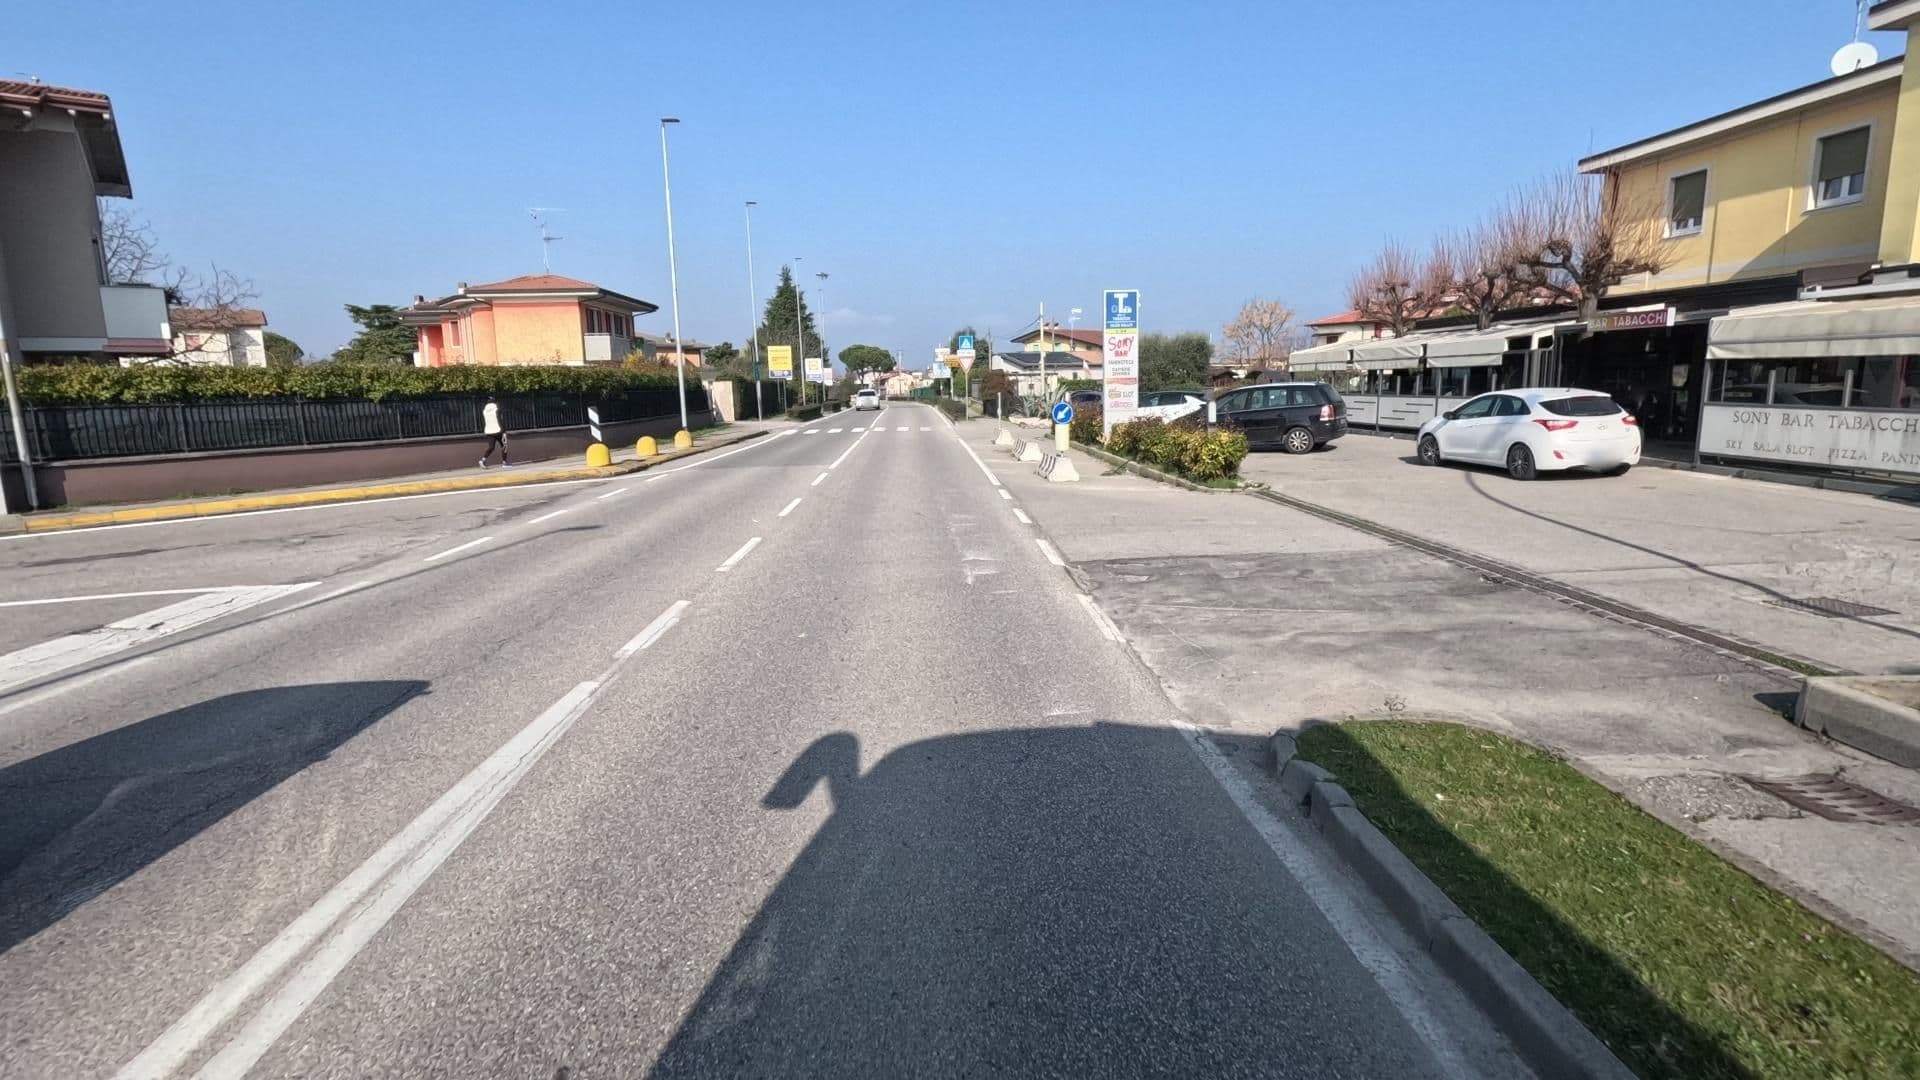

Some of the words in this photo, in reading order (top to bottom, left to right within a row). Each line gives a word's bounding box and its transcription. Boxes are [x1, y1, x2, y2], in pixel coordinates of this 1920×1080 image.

[1589, 318, 1608, 329] BAR
[1613, 311, 1667, 328] TABACCHI
[1732, 410, 1771, 425] SONY
[1780, 412, 1814, 428] BAR
[1725, 439, 1743, 449] SKY
[1785, 443, 1815, 457] SLOT
[1827, 448, 1868, 461] PIZZA
